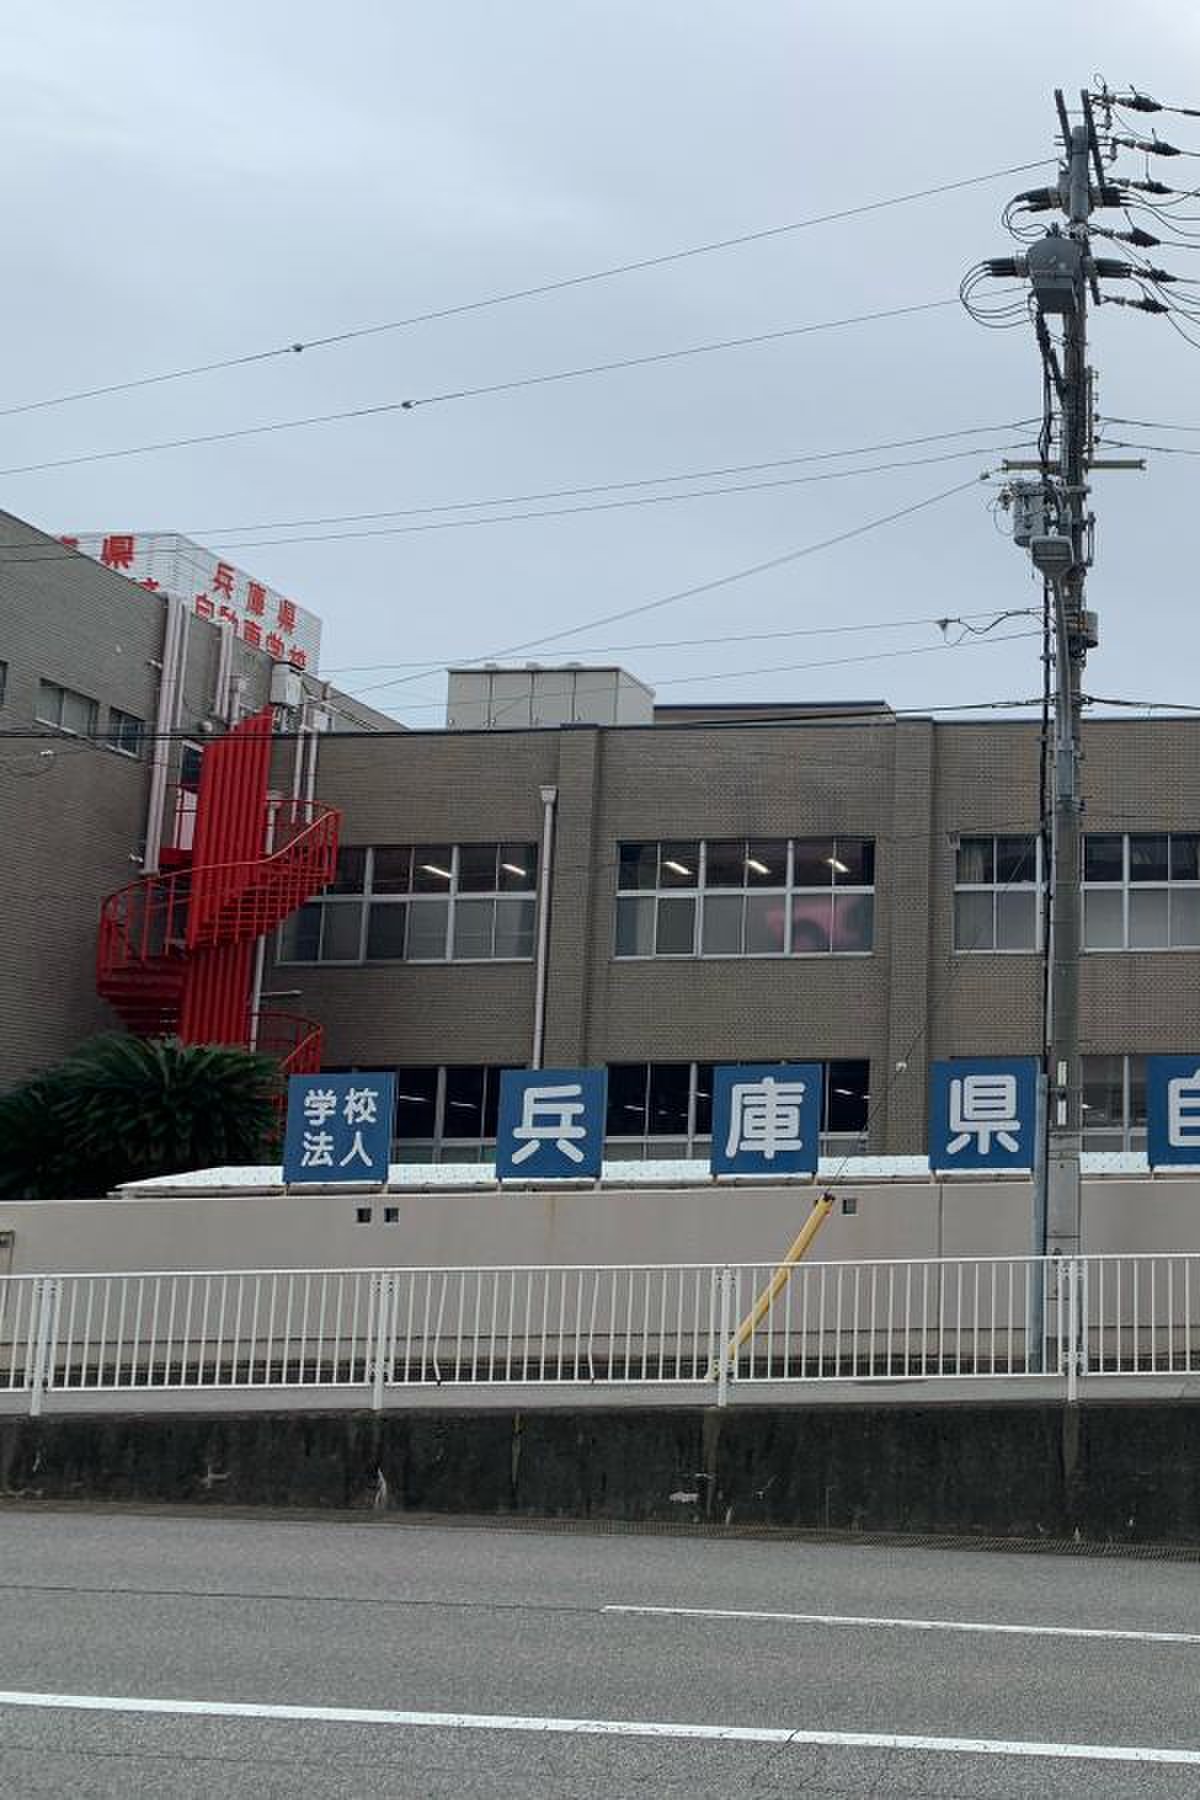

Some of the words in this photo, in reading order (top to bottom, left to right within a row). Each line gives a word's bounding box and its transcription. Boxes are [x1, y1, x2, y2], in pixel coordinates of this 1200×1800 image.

[213, 562, 298, 636] 兵庫県
[303, 1087, 378, 1126] 学校
[300, 1131, 373, 1168] 法人
